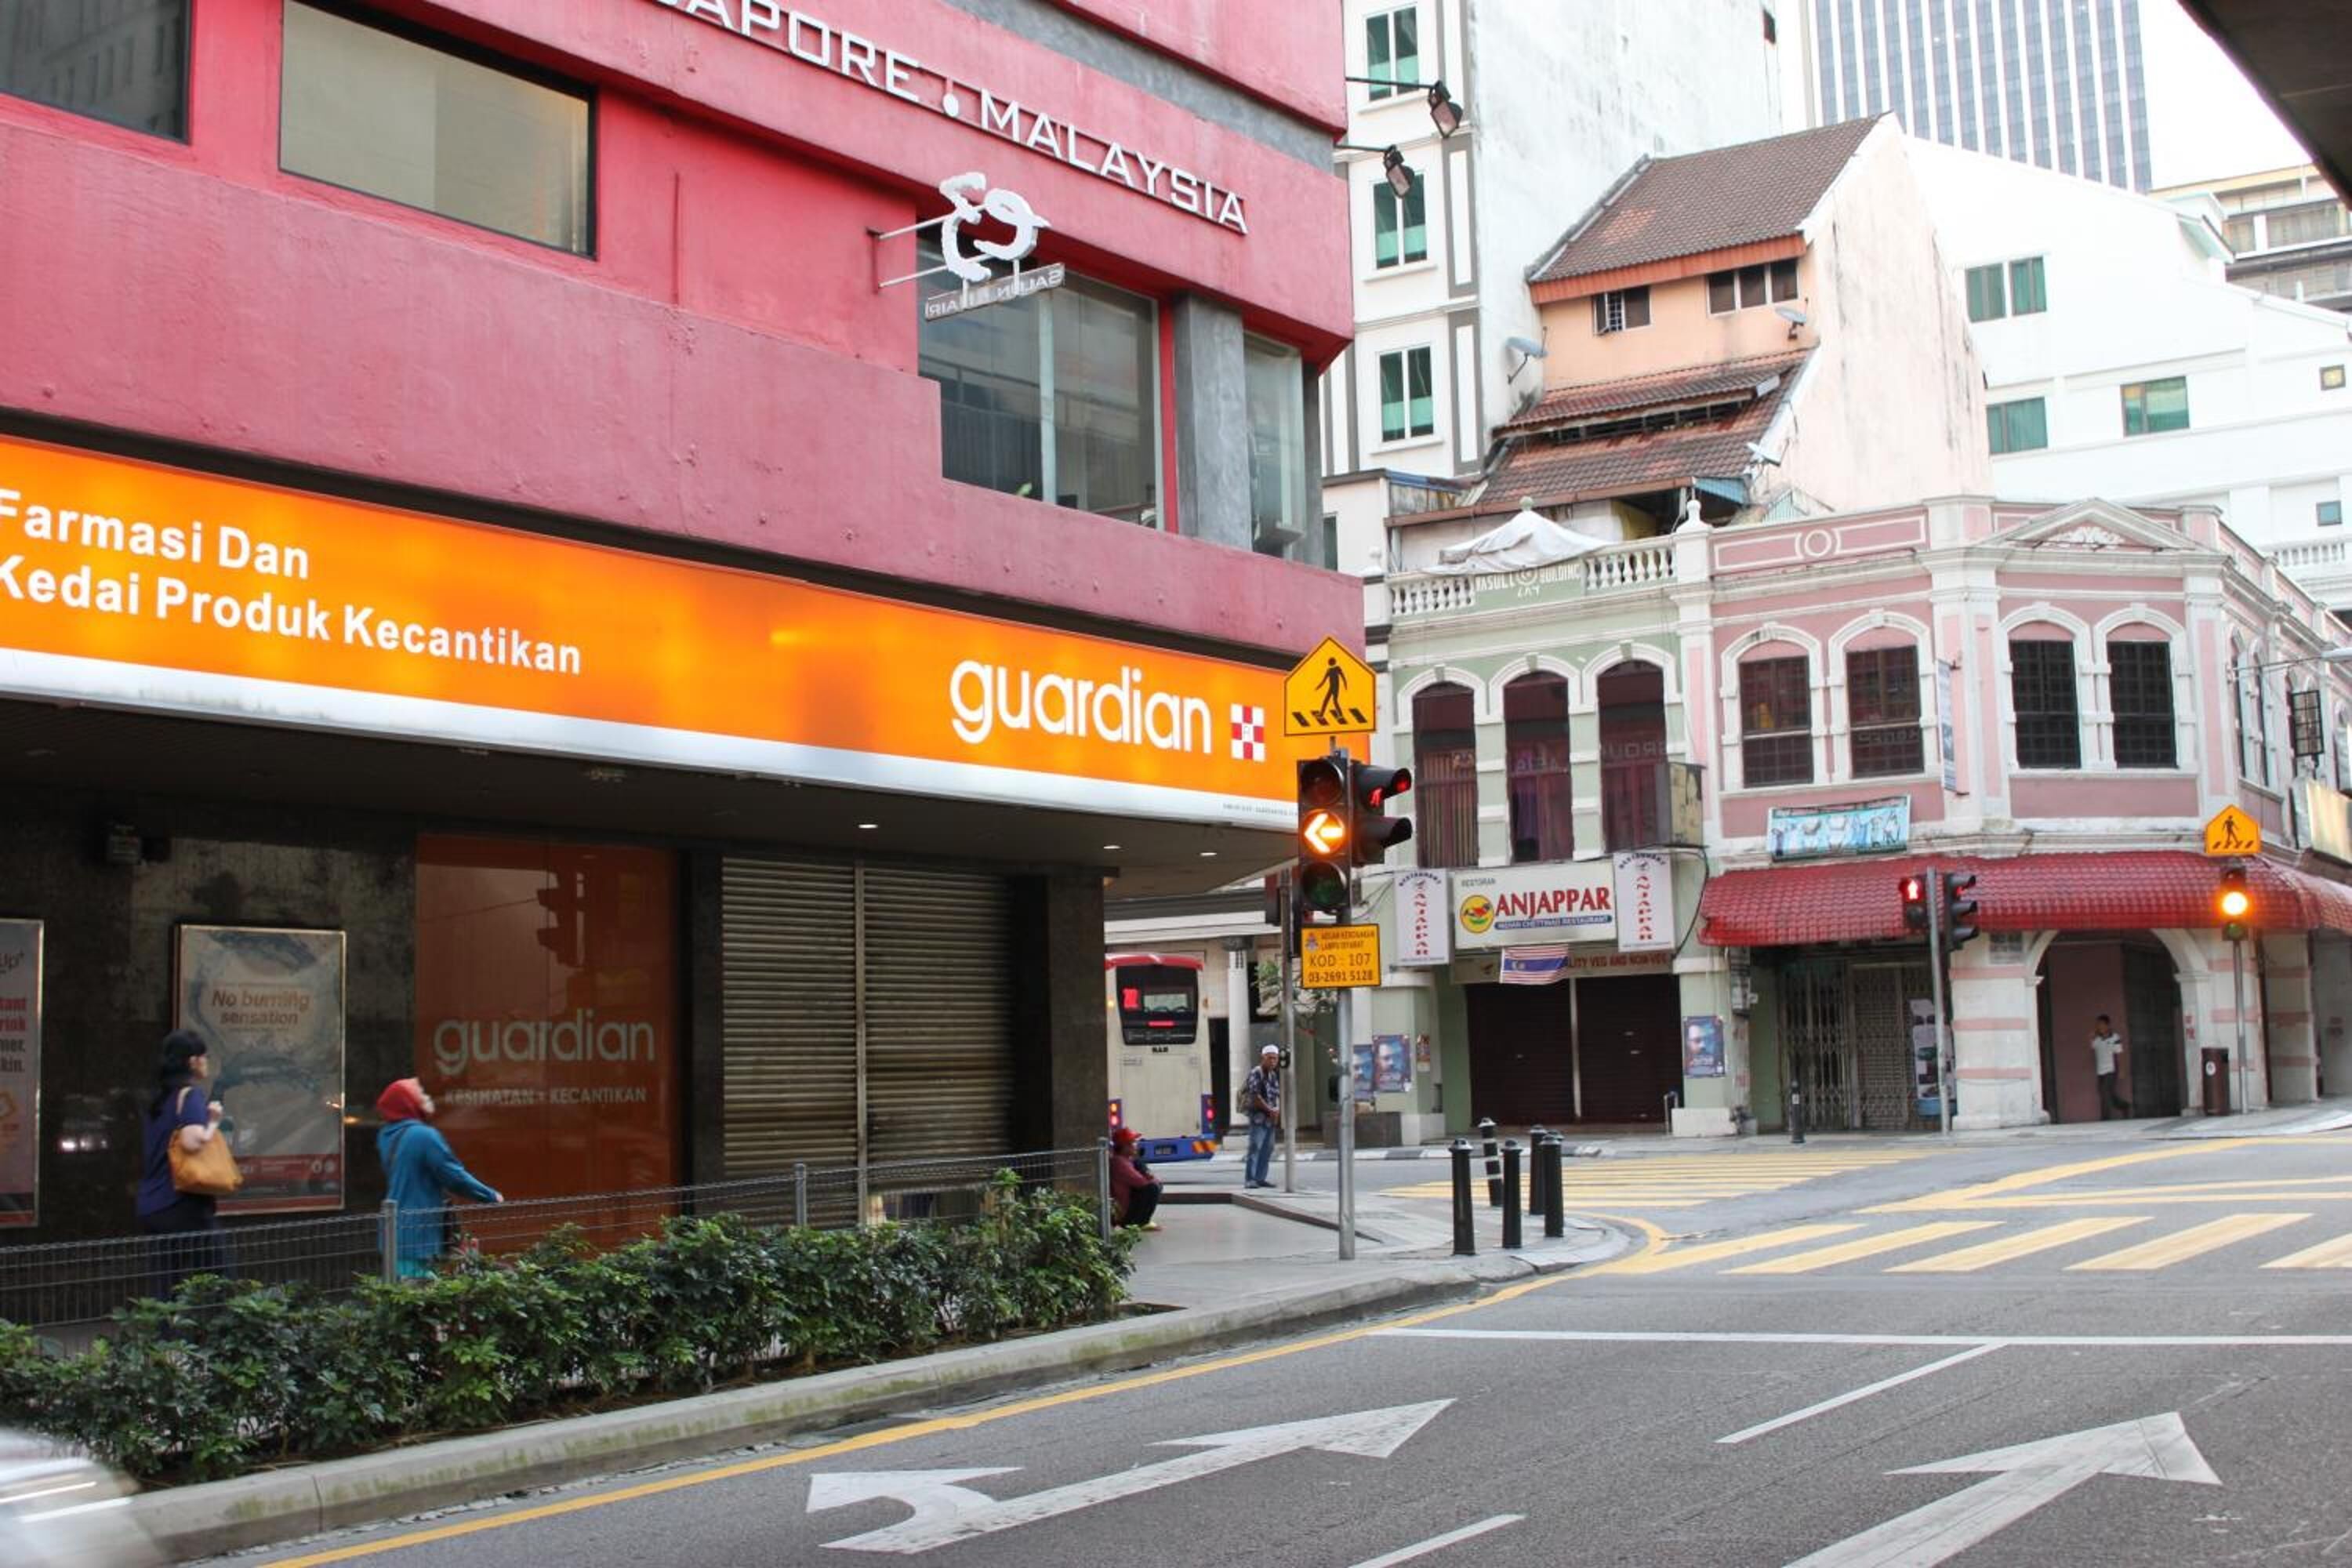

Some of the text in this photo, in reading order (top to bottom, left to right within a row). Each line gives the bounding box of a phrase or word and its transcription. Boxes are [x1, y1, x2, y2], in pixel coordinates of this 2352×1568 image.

[656, 0, 920, 103] APORE
[981, 88, 1248, 234] MALAYSIA
[0, 488, 309, 579] Farmasi Dan
[0, 554, 581, 675] Kedai Produk Kecantikan
[949, 659, 1212, 753] guardian
[1495, 887, 1611, 918] ANJAPPAR
[212, 988, 238, 1007] No
[1309, 954, 1337, 967] KOD
[1348, 953, 1370, 967] 107
[220, 1010, 299, 1025] sensation
[434, 1007, 655, 1076] guardian
